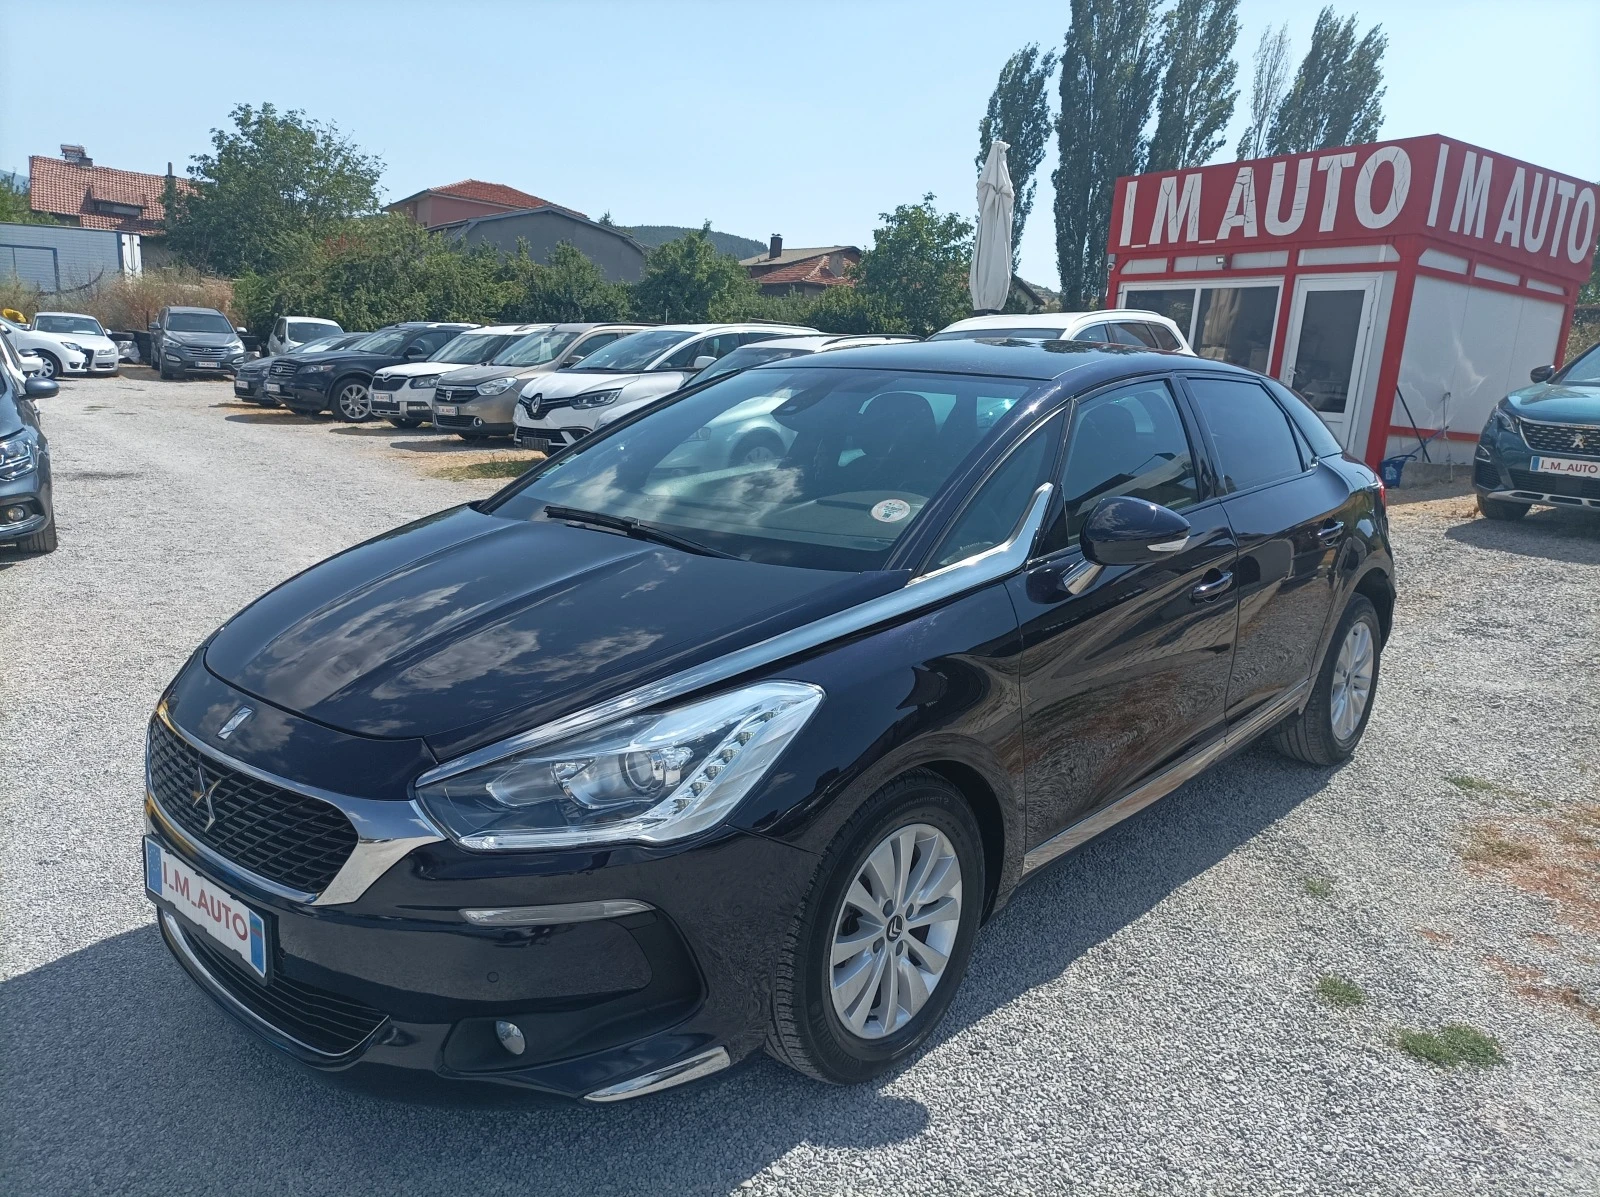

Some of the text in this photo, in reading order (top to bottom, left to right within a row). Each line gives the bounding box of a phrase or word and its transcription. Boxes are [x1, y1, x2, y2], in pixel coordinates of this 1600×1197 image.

[1427, 143, 1595, 264] I M AUTO
[1541, 460, 1598, 473] I_M_AUTO
[163, 862, 248, 941] I_M_AUTO
